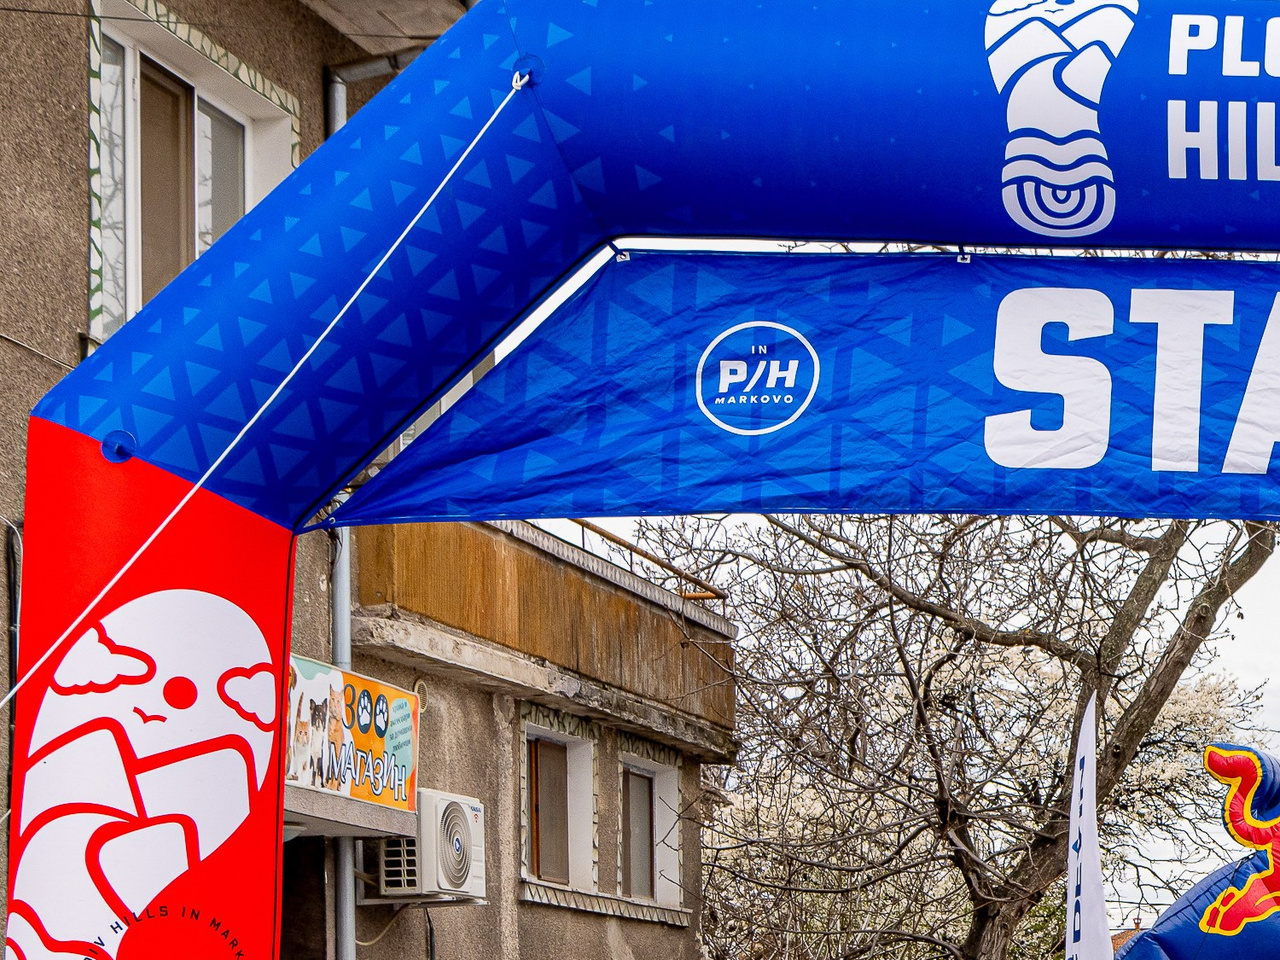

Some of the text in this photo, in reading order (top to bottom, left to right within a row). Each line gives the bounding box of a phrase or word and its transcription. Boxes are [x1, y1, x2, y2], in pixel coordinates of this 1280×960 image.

[752, 345, 767, 354] IN
[718, 360, 799, 393] P/H
[715, 395, 794, 404] MARKOVO
[328, 741, 407, 801] МАГАЗИН
[110, 906, 168, 934] HILLS
[181, 907, 200, 921] IN
